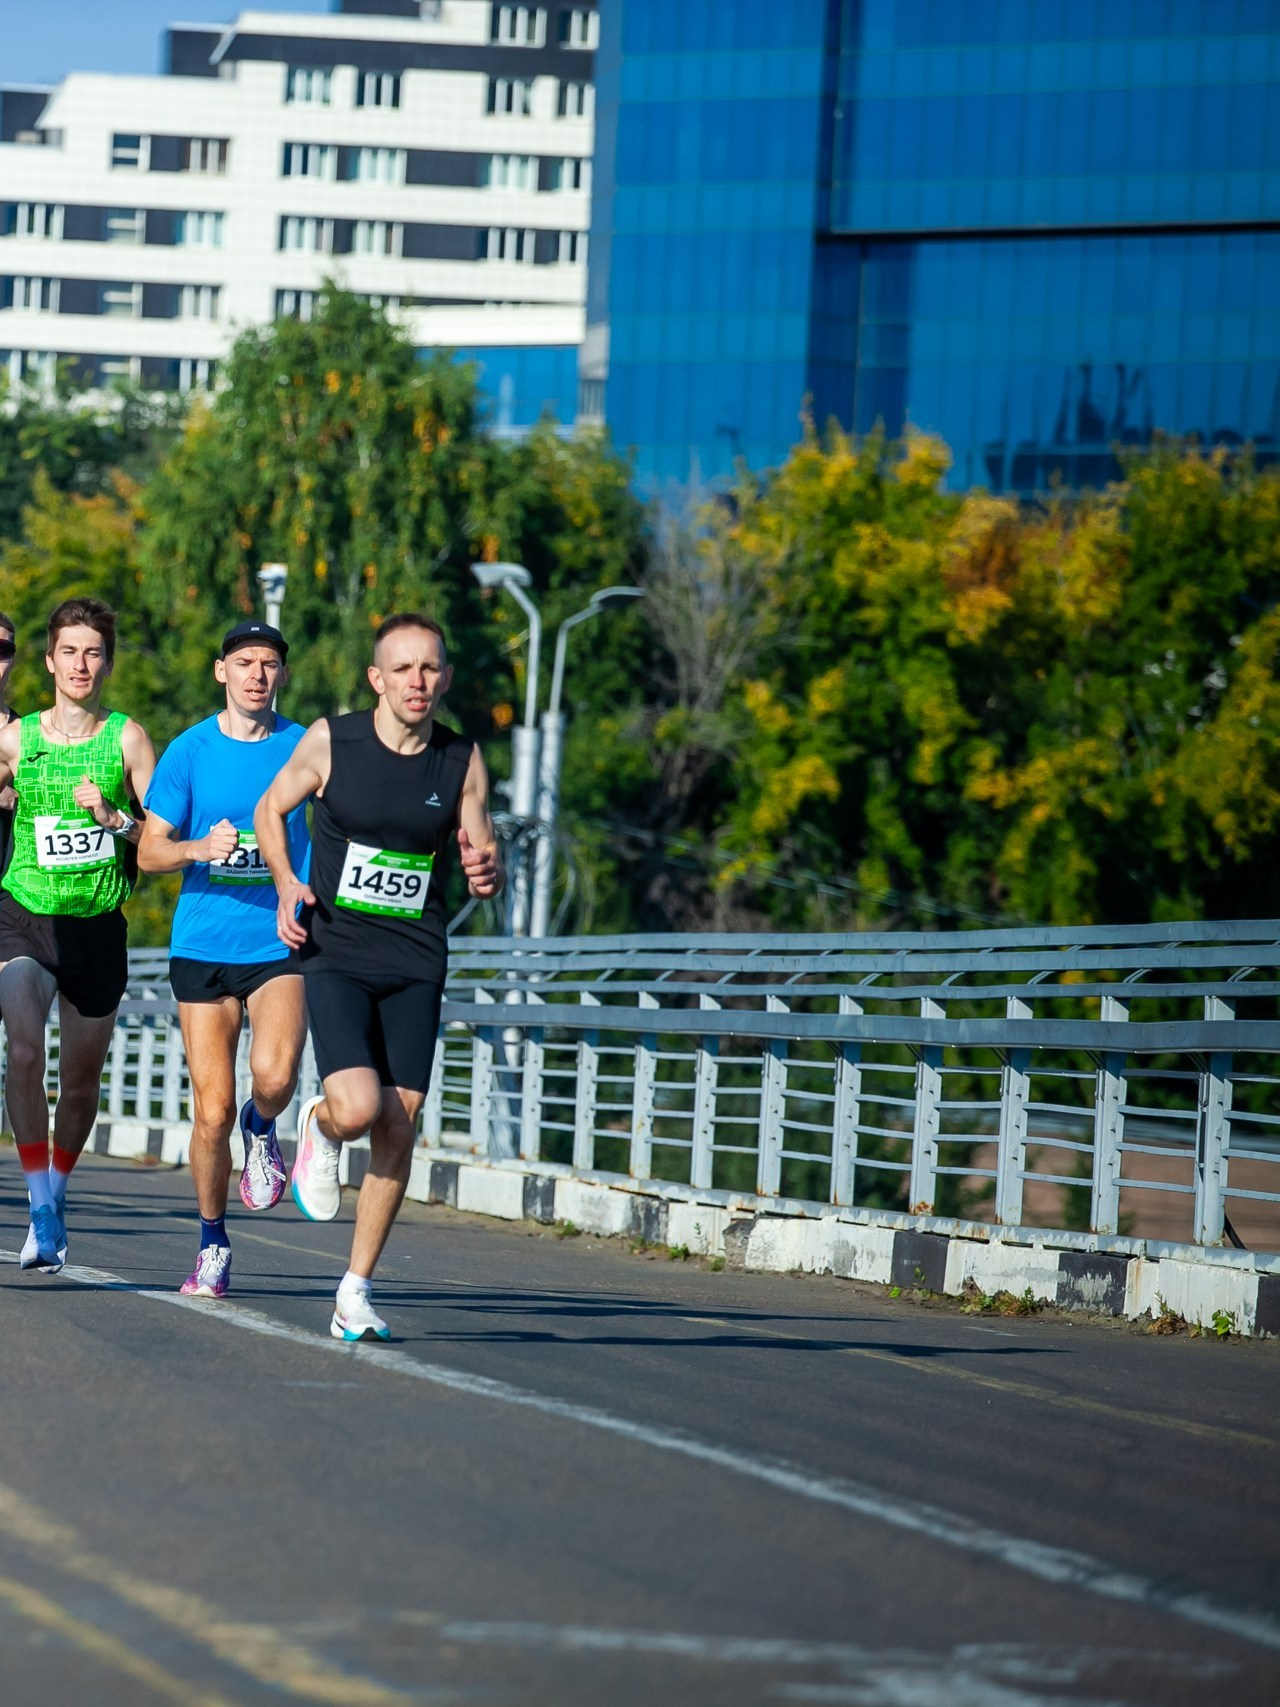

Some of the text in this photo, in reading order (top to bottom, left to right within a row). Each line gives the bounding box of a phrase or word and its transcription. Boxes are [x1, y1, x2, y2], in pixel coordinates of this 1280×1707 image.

[45, 828, 106, 856] 1337
[221, 847, 269, 869] 131
[348, 865, 422, 899] 1459
